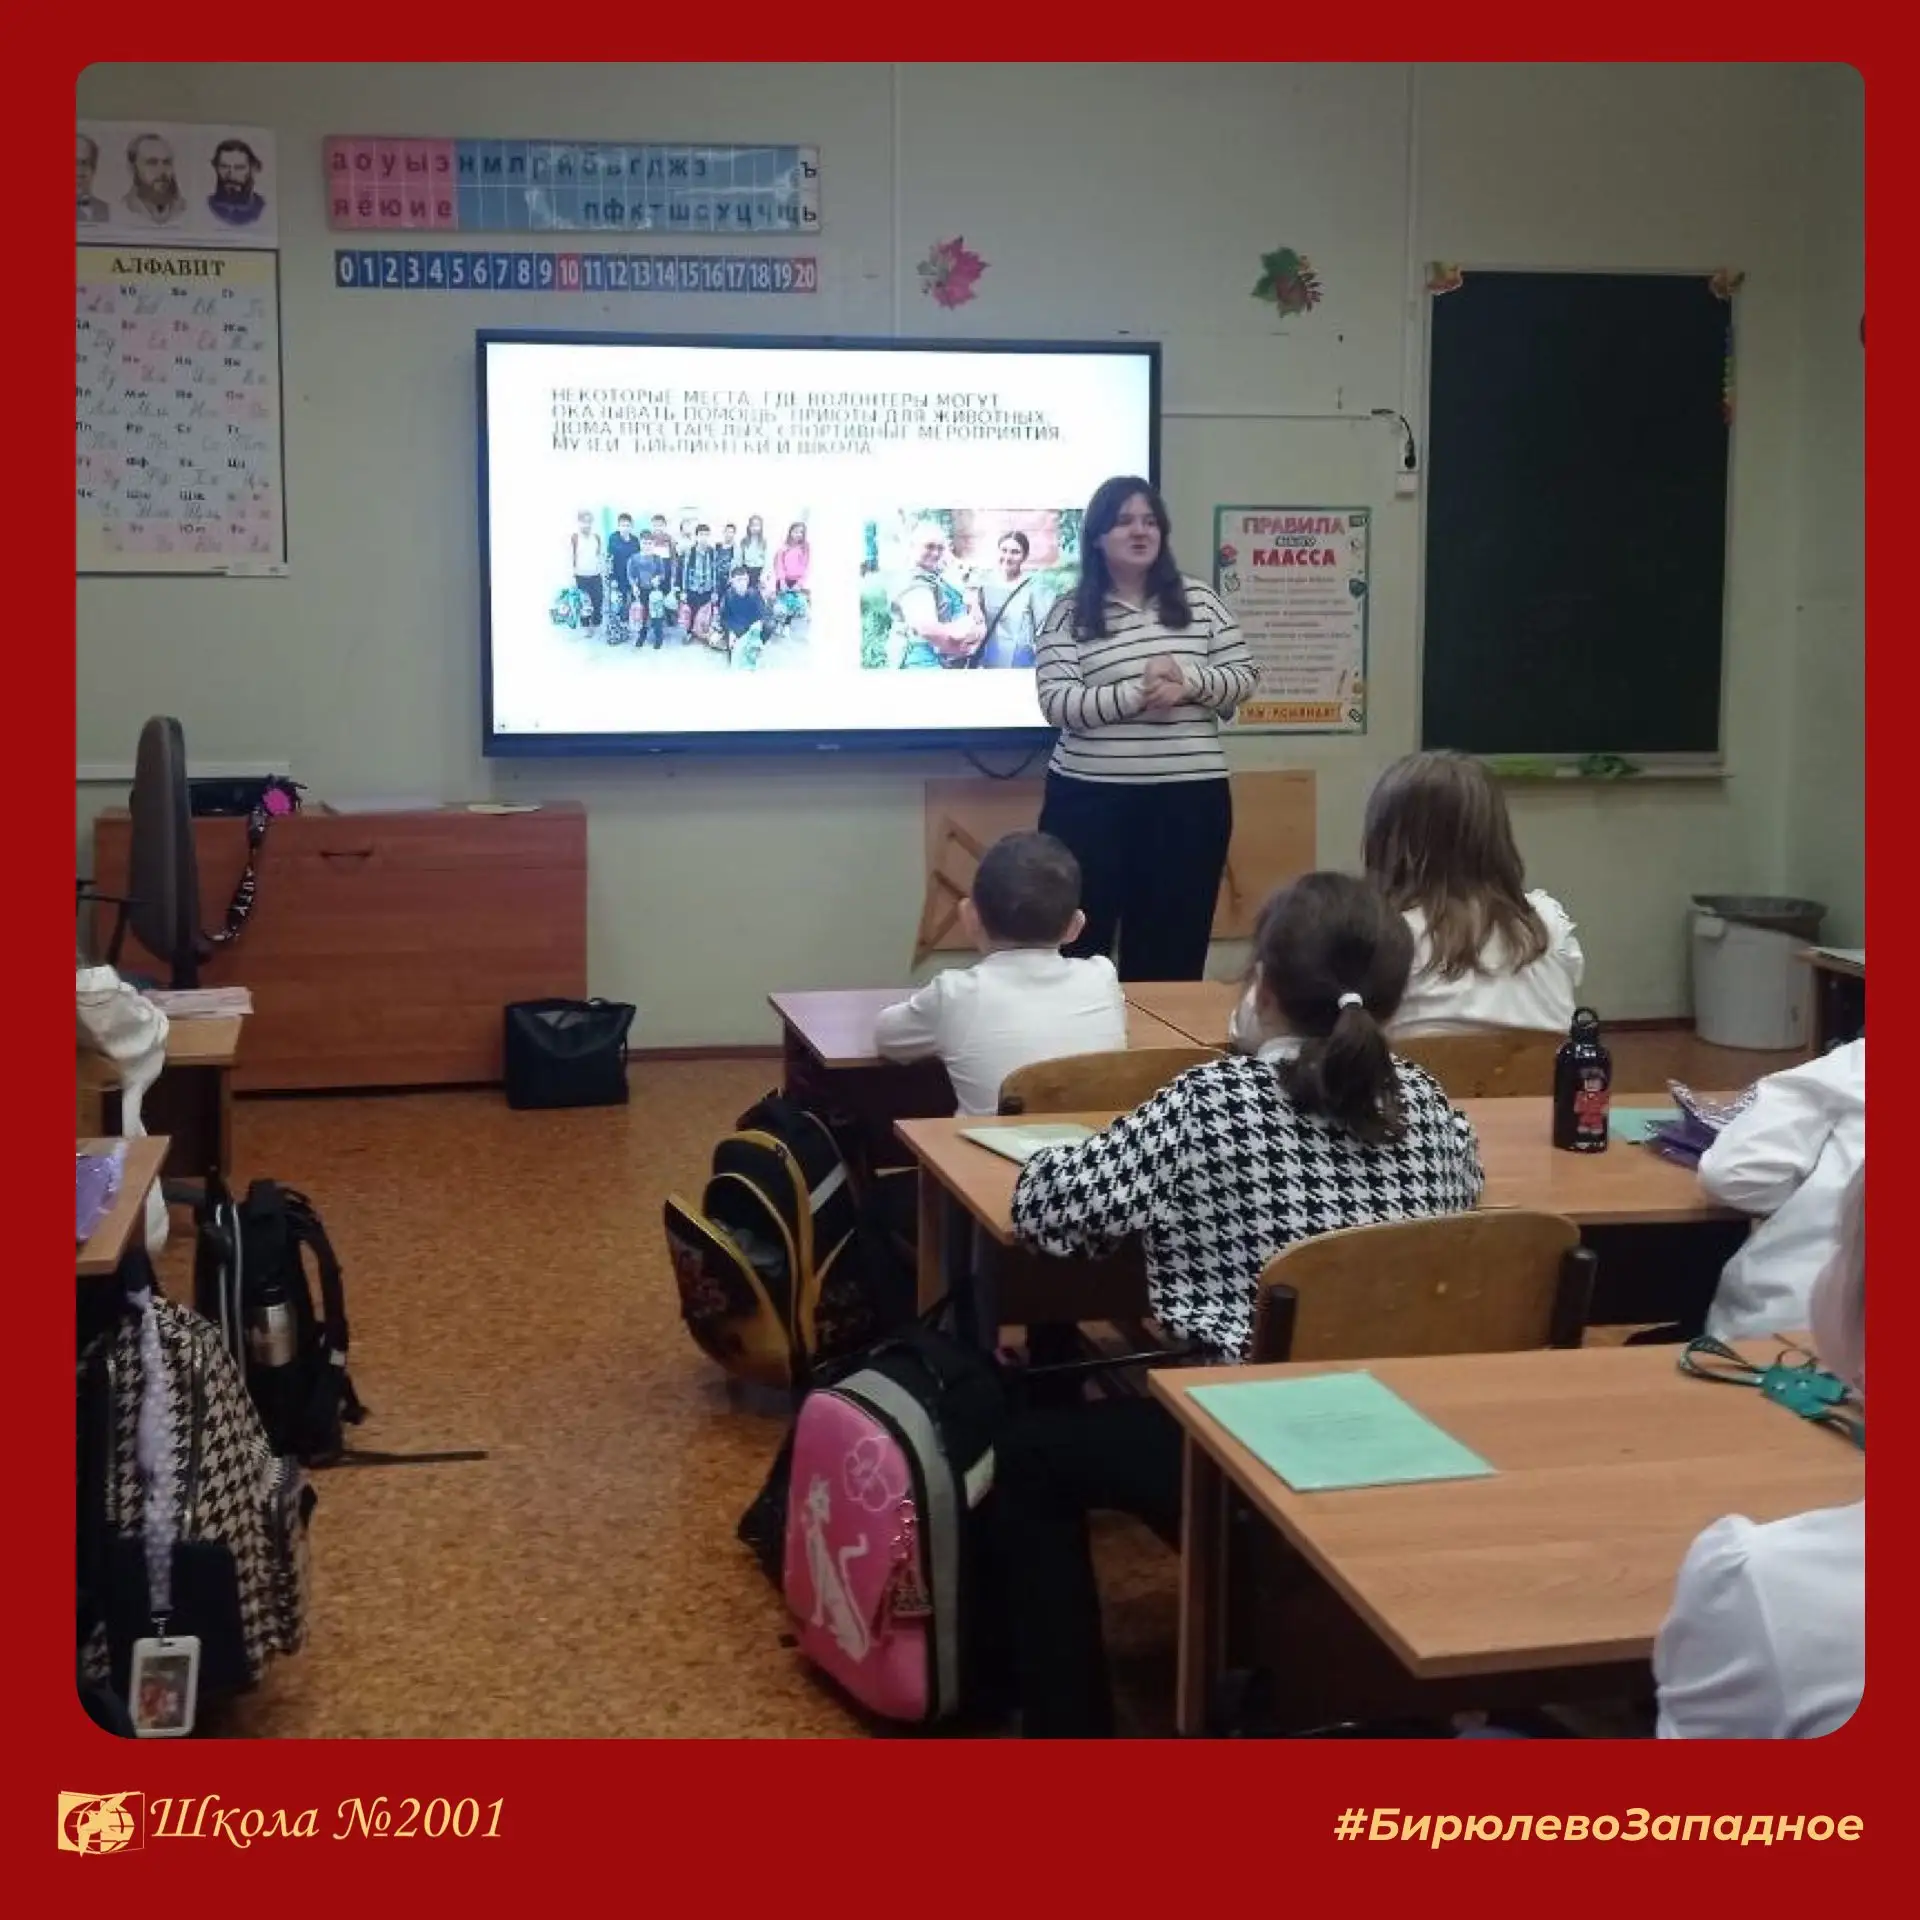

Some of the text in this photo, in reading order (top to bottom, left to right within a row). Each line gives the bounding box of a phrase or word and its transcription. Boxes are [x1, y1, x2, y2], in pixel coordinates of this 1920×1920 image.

[112, 257, 226, 277] АЛФАВИТ
[340, 257, 815, 289] 0 1 2 3 4 5 6 7 8 9 10 11 12 13 14 15 16 17 18 19 20
[552, 388, 671, 404] НЕКОТОРЫЕ
[936, 392, 1000, 408] МОГУТ
[777, 440, 790, 454] И
[1242, 516, 1346, 535] ПРАВИЛА
[1252, 549, 1337, 566] КЛАССА
